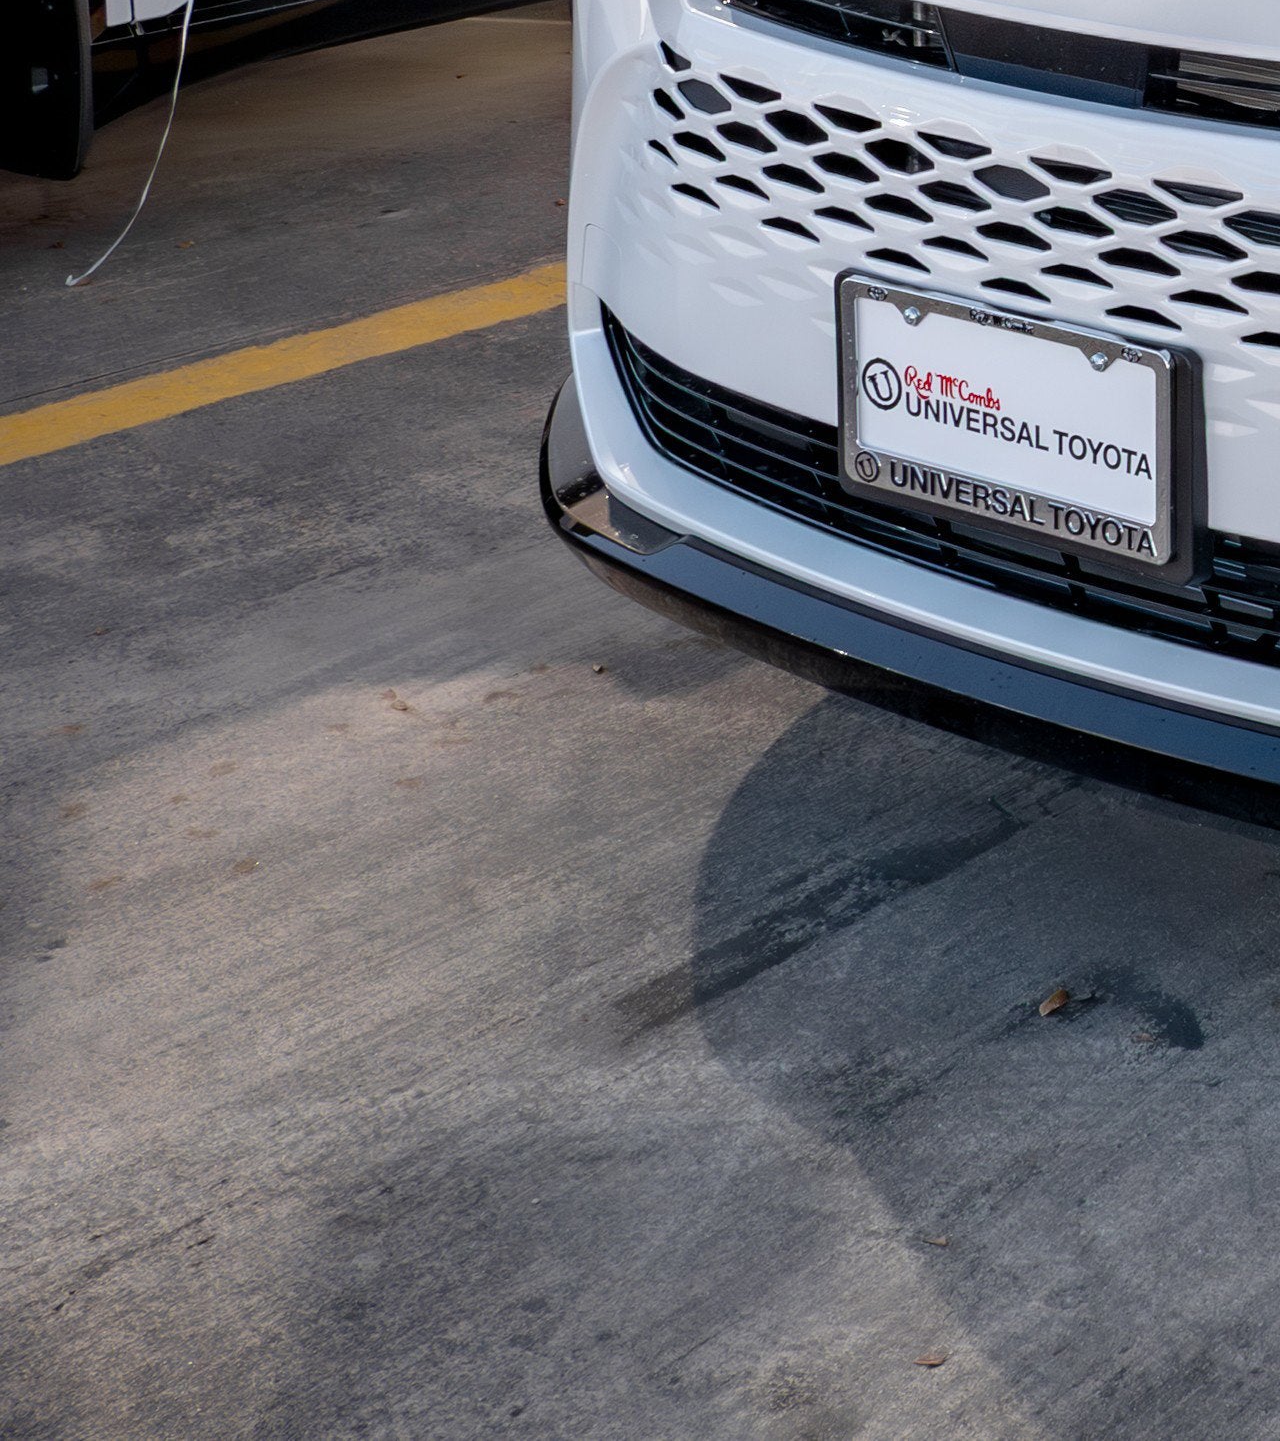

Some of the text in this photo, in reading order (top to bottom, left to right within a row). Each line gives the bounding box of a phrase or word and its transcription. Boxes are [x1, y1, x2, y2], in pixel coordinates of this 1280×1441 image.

[904, 365, 1001, 411] Red McCombs
[905, 391, 1153, 480] UNIVERSAL TOYOTA
[890, 460, 1158, 558] UNIVERSAL TOYOTA
